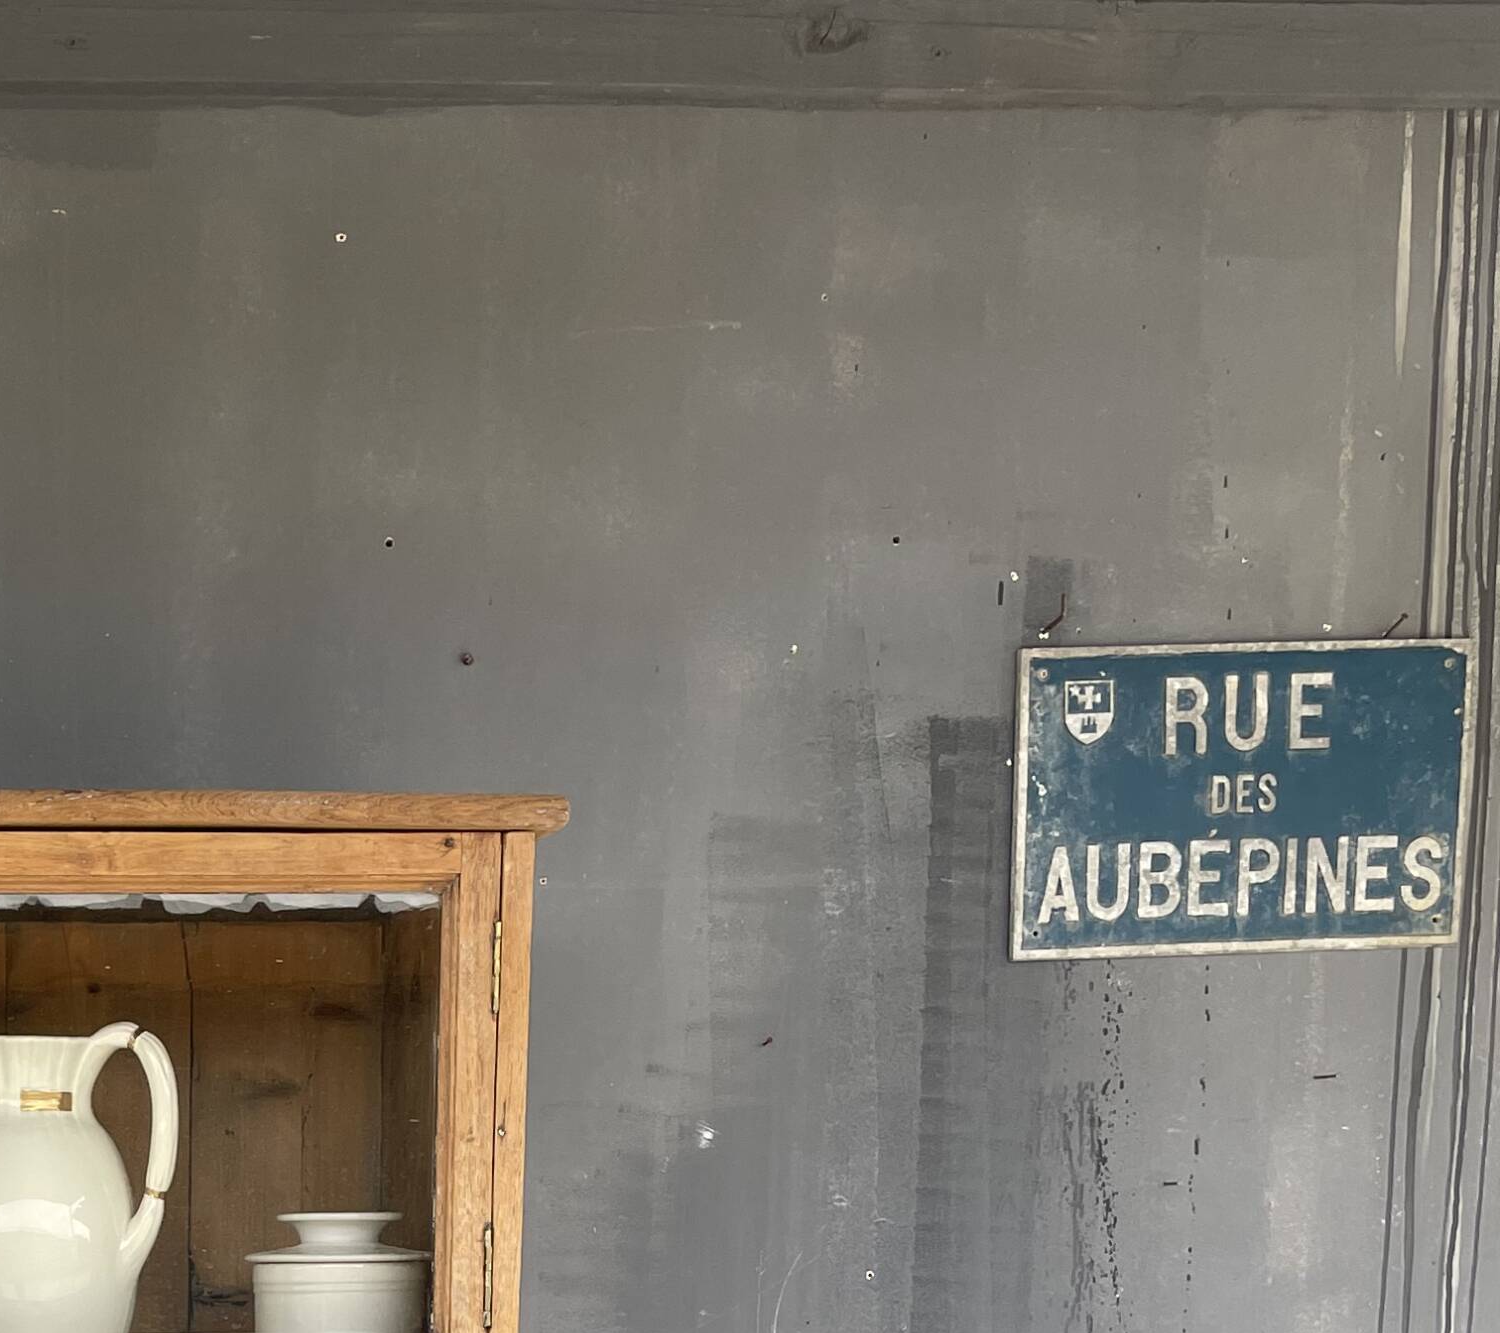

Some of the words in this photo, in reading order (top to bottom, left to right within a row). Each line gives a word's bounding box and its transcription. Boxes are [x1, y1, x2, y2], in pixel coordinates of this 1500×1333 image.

[1164, 671, 1334, 756] RUE
[1210, 773, 1277, 815] DES
[1037, 829, 1444, 925] AUBÉPINES
